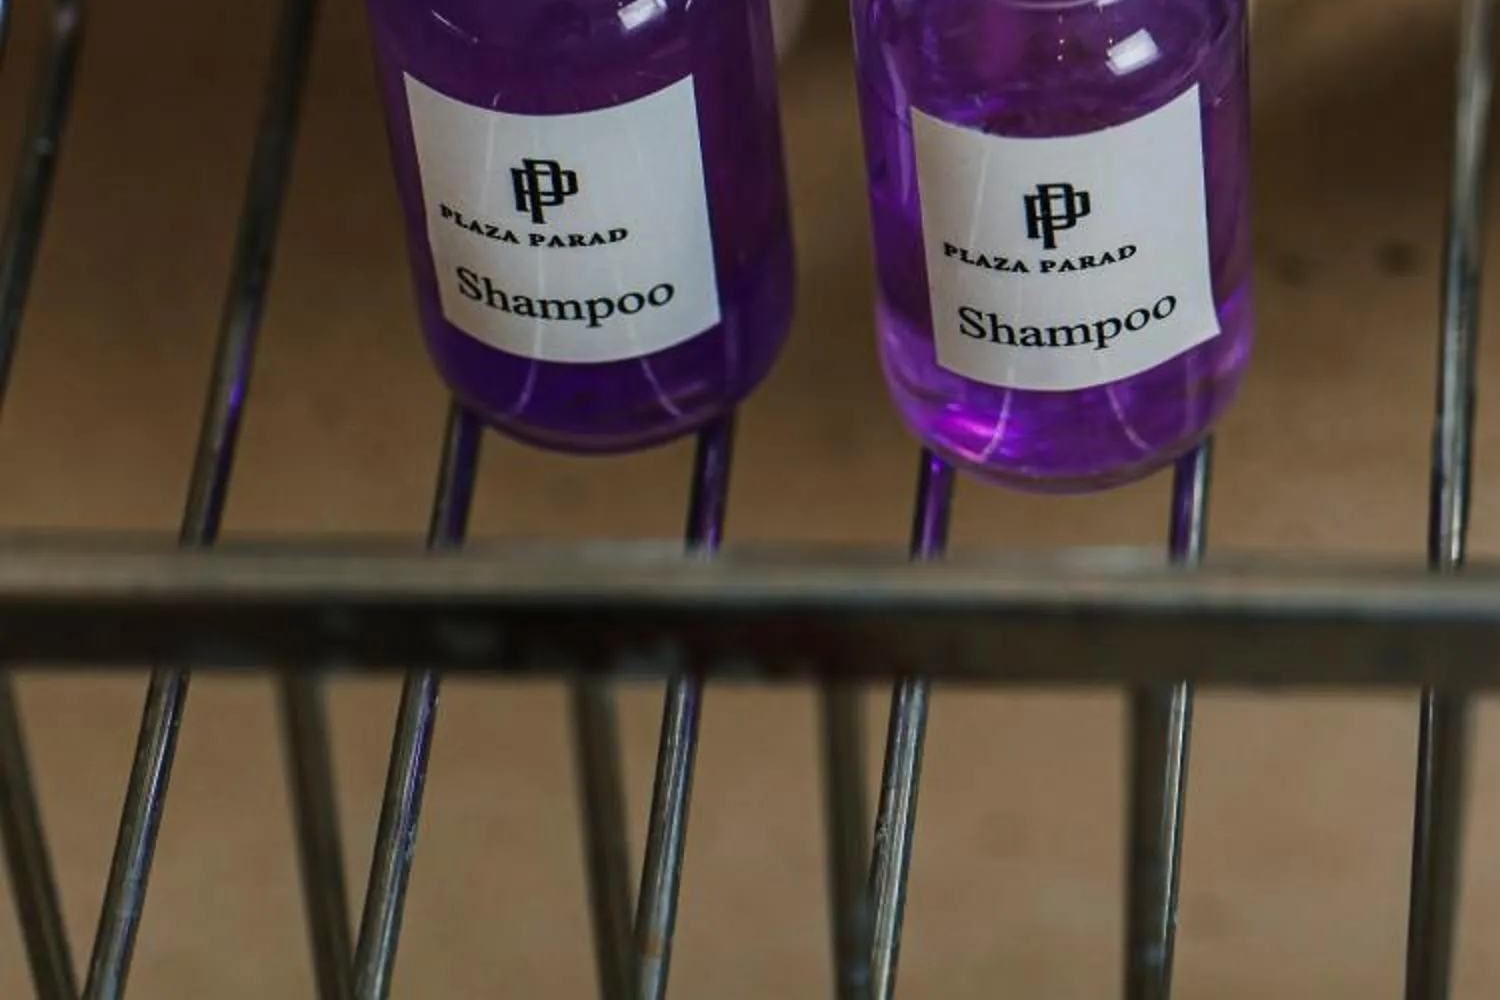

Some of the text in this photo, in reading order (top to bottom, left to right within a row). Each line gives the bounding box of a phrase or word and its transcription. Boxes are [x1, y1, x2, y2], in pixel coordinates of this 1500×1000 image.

[438, 203, 629, 249] PLAZA PARAD
[942, 241, 1138, 273] PLAZA PARAD
[455, 265, 676, 328] Shampoo
[957, 294, 1178, 351] Shampoo
